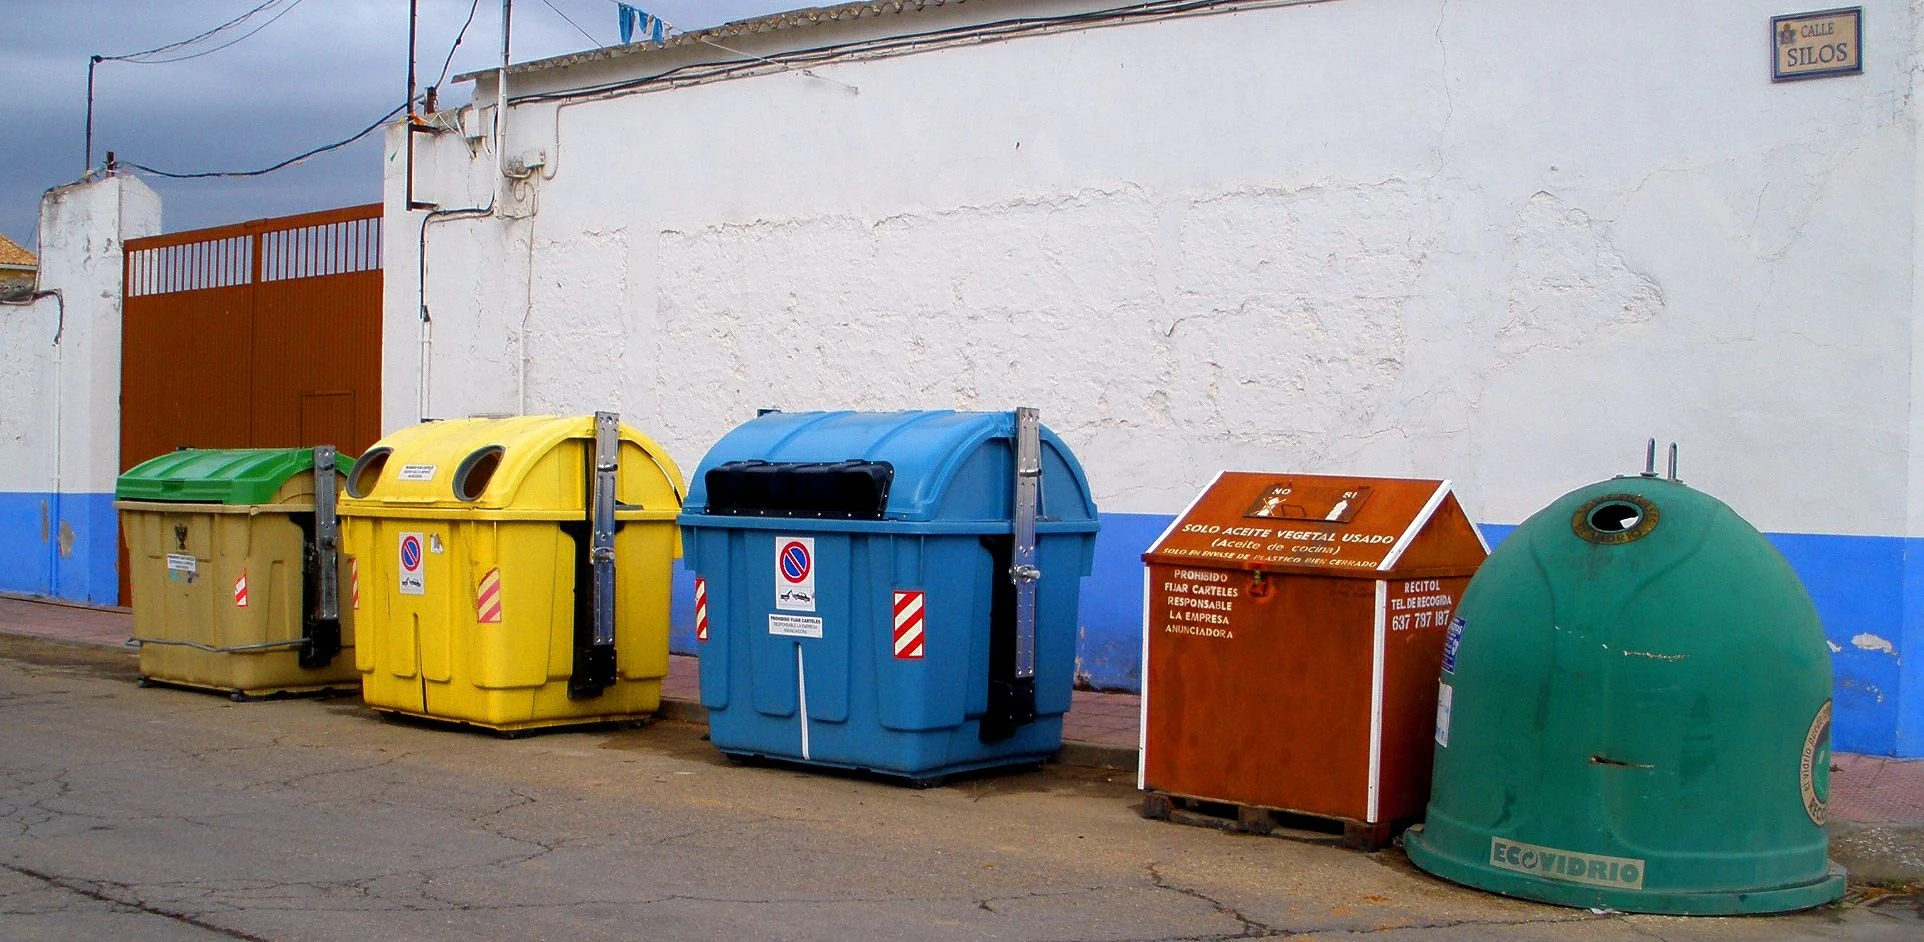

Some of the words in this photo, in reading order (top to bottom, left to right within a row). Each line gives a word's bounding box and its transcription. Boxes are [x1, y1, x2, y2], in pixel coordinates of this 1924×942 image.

[1801, 22, 1834, 38] CALLE
[1787, 42, 1847, 67] SILOS
[1272, 487, 1292, 495] NO
[1342, 491, 1358, 499] SI
[1182, 523, 1220, 534] SOLO
[1221, 527, 1272, 538] ACEITE
[1277, 530, 1337, 542] VEGETAL
[1341, 533, 1395, 545] USADO
[1211, 538, 1261, 550] (Aceite
[1266, 542, 1284, 552] de
[1291, 545, 1341, 555] cocina)
[1162, 547, 1187, 556] SOLO
[1201, 550, 1235, 559] ENVASE
[1253, 554, 1301, 564] PLASTICO
[1329, 559, 1378, 568] CERRADO
[1174, 569, 1228, 582] PROHIBIDO
[1164, 582, 1189, 593] FIJAR
[1192, 584, 1239, 597] CARTELES
[1404, 580, 1440, 593] RECITOL
[1167, 596, 1232, 611] RESPONSABLE
[1407, 597, 1416, 609] DE
[1416, 594, 1452, 608] RECOGIDA
[1169, 610, 1182, 620] LA
[1185, 612, 1229, 625] EMPRESA
[1392, 613, 1411, 631] 637
[1435, 609, 1450, 627] 187
[1165, 624, 1233, 639] ANUNCIADORA
[1802, 748, 1812, 780] vidrio
[1493, 842, 1640, 884] ECOVIDRIO
